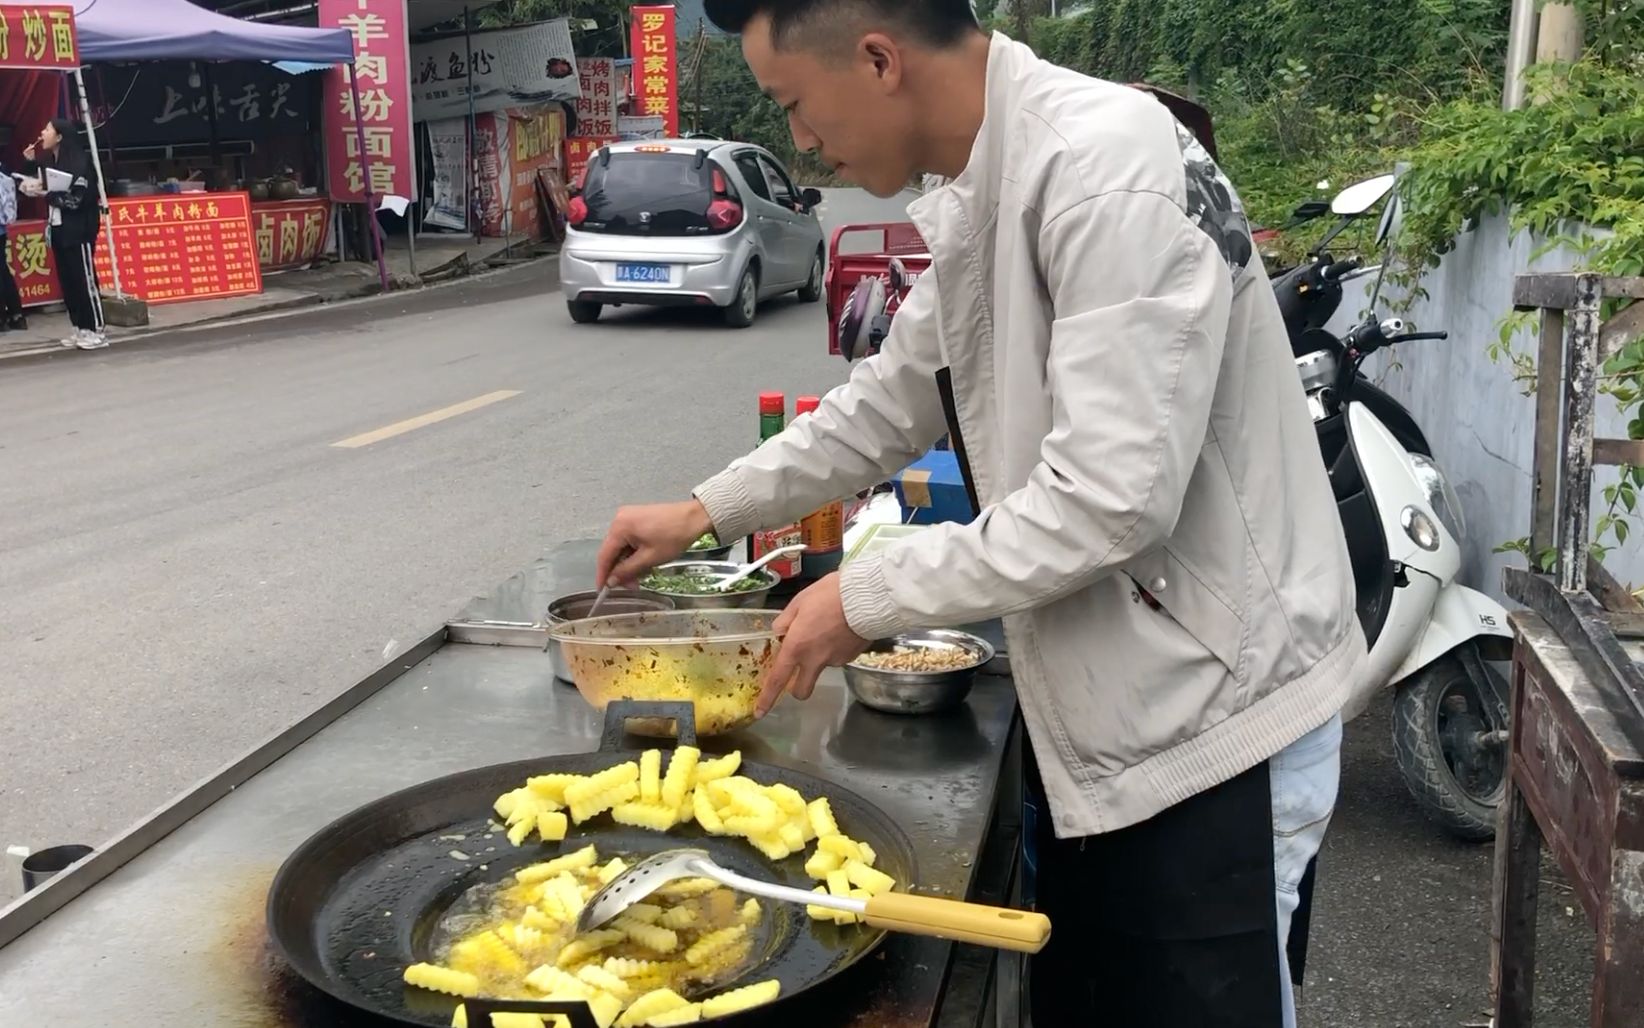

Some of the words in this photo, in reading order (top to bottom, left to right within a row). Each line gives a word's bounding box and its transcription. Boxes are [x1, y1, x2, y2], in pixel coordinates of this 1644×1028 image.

[22, 9, 75, 62] 炒面
[411, 49, 495, 86] 渡鱼粉
[641, 13, 671, 138] 罗记家常菜
[338, 0, 397, 195] 羊肉粉面馆
[591, 60, 613, 135] 烤肉拌饭
[256, 212, 322, 264] 卤肉饭
[1478, 614, 1497, 627] HS
